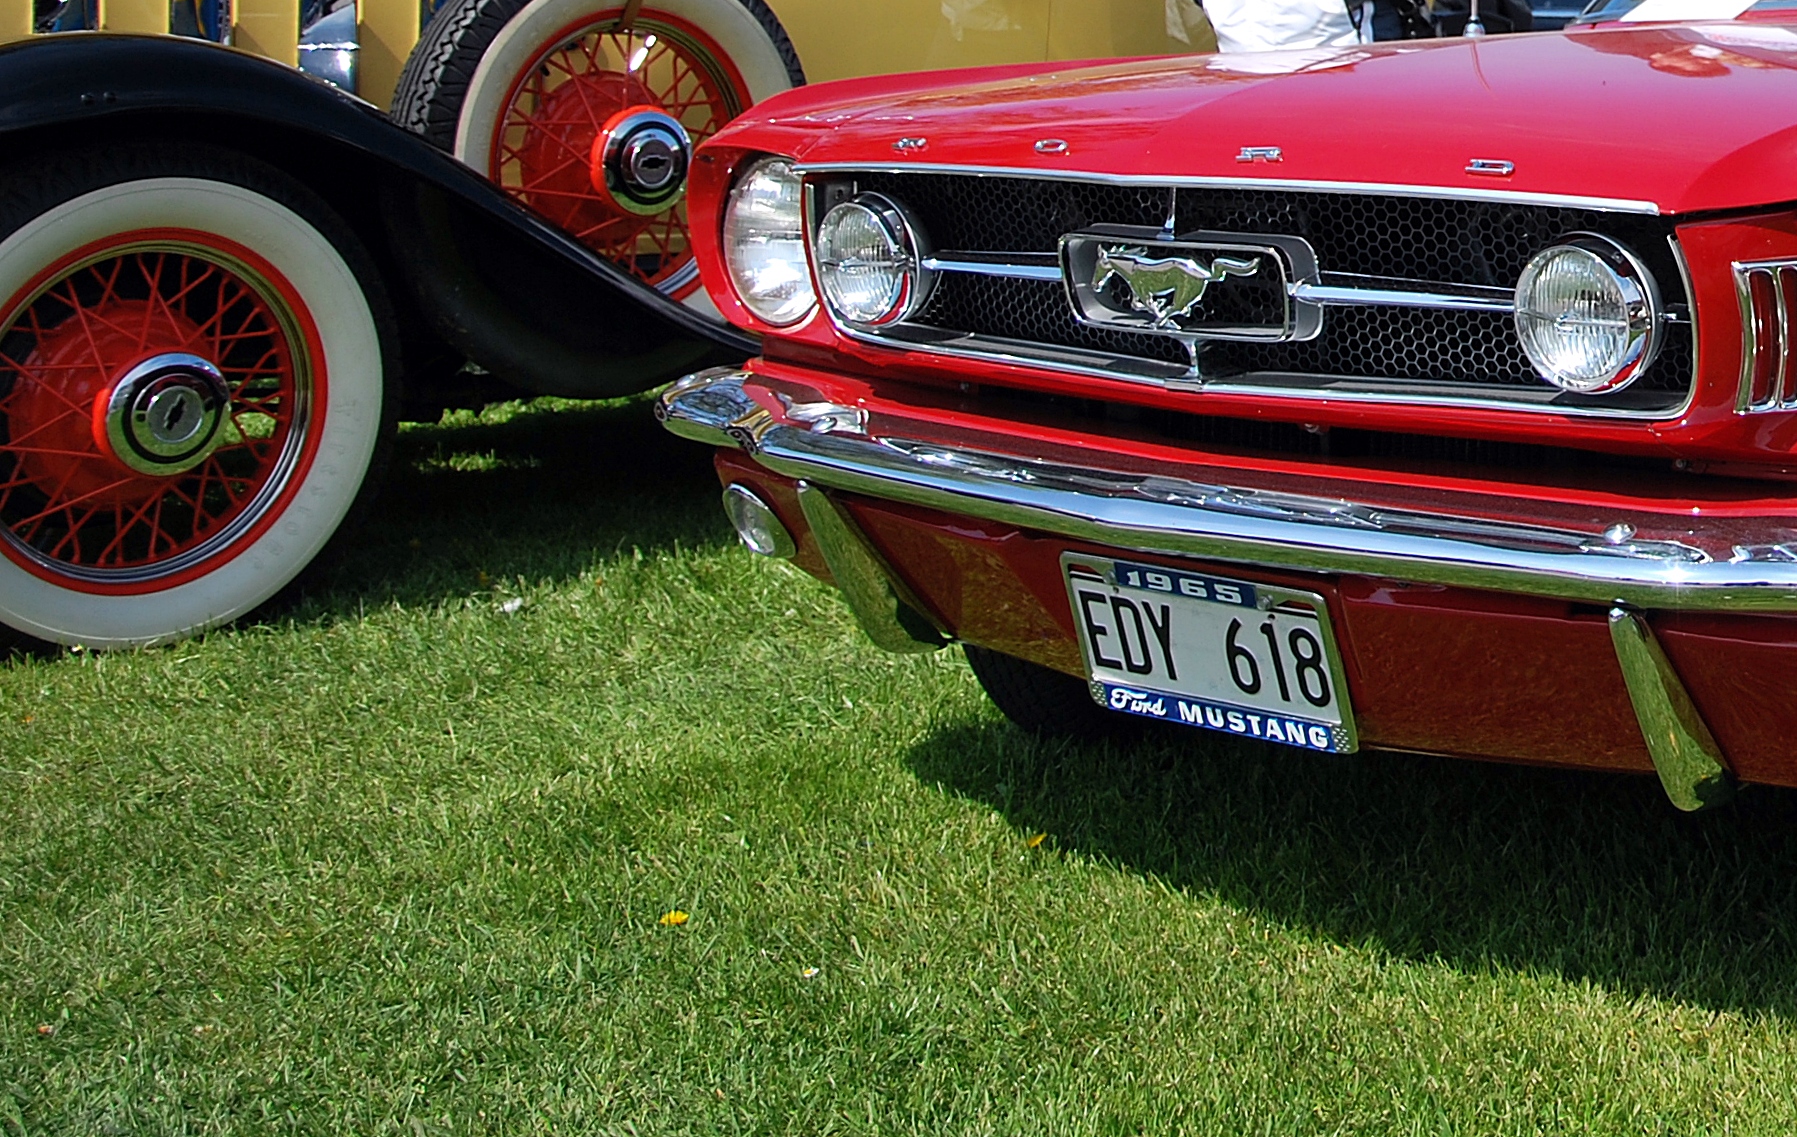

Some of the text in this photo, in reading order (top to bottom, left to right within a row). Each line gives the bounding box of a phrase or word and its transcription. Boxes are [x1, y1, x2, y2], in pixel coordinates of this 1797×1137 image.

[1125, 570, 1243, 605] 1965
[1079, 589, 1332, 708] EDY 618
[1109, 687, 1330, 749] Ford MUSTANG
